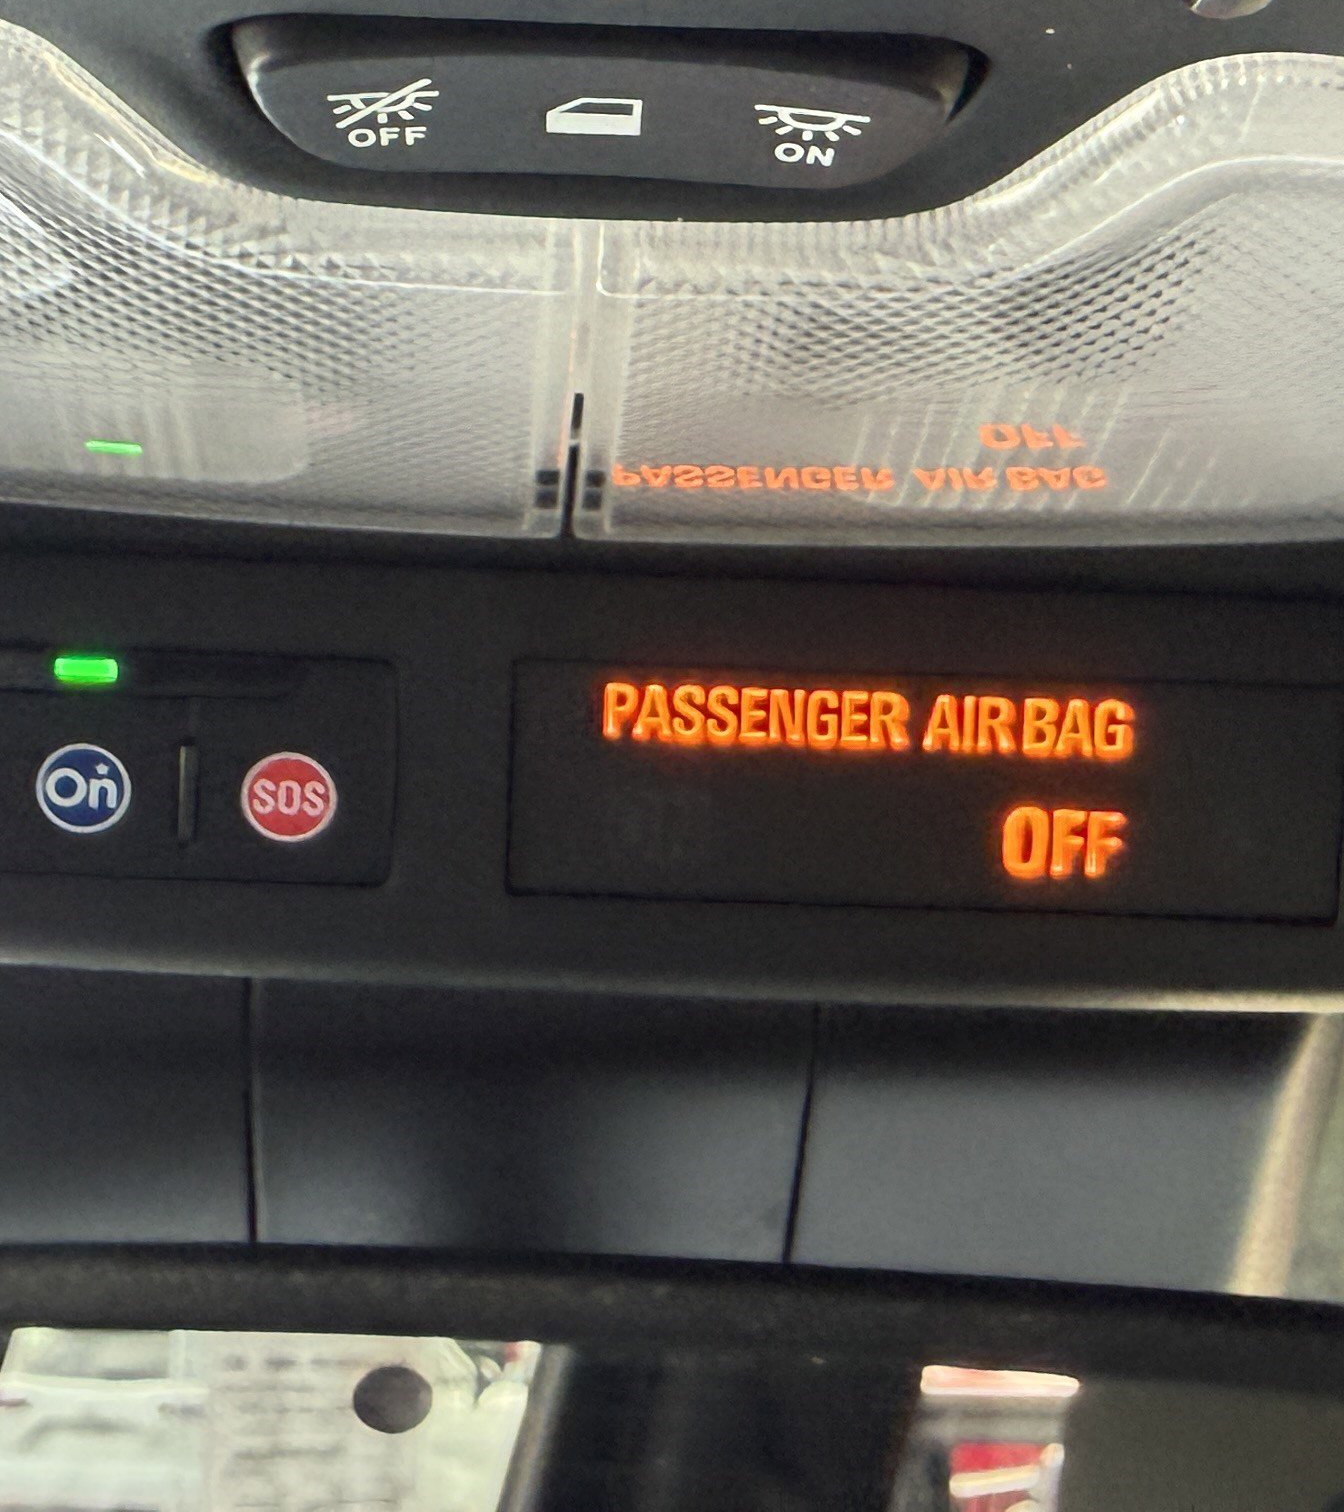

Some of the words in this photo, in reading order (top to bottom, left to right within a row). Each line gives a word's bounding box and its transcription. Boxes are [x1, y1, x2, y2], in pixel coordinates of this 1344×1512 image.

[347, 125, 428, 148] OFF
[774, 141, 836, 168] ON
[602, 681, 911, 751] PASSENGER
[44, 764, 118, 810] On
[252, 777, 326, 817] SOS
[1001, 805, 1128, 881] OFF
